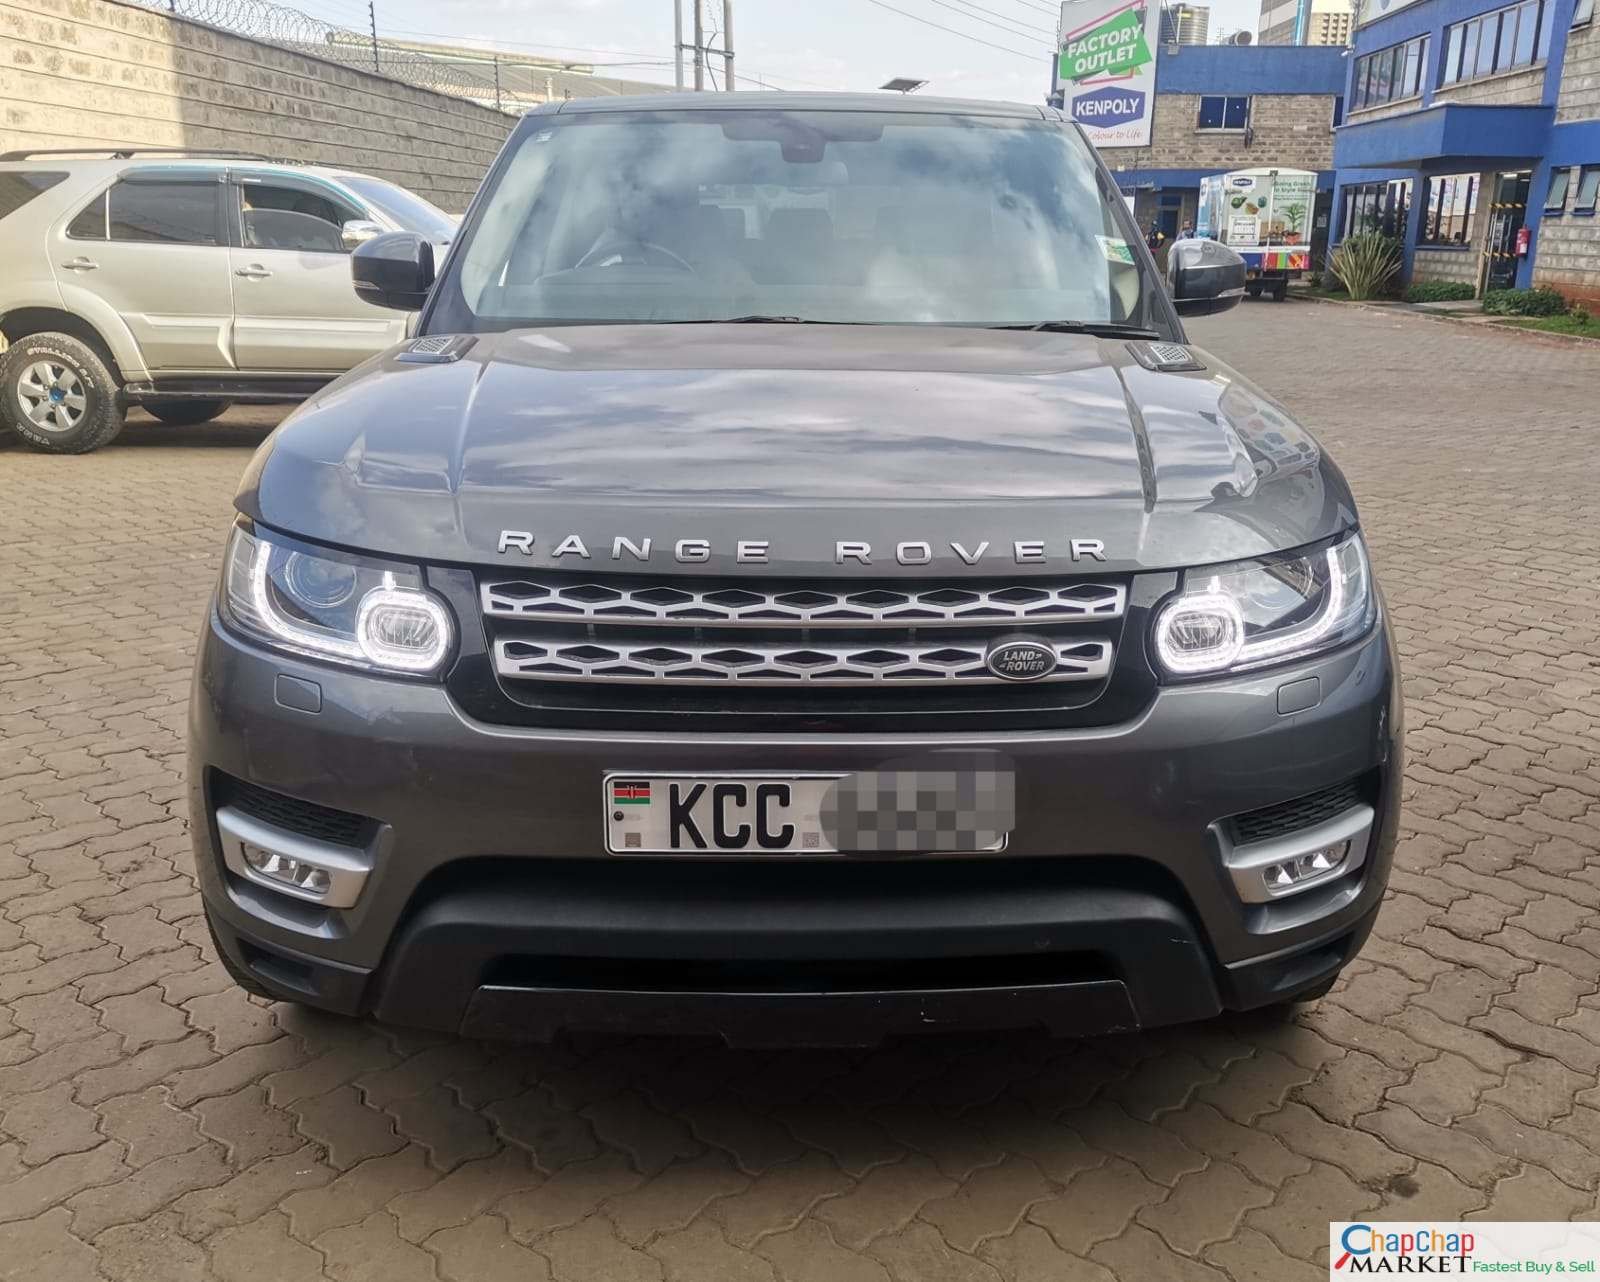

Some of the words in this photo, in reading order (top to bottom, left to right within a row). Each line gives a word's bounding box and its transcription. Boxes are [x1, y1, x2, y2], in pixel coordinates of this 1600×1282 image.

[1067, 24, 1142, 58] FACTORY
[1075, 44, 1136, 74] OUTLET
[1075, 98, 1139, 116] KENPOLY
[498, 530, 769, 563] RANGE
[836, 538, 1107, 565] ROVER
[1003, 651, 1036, 661] LAND
[1006, 661, 1045, 671] ROVER
[669, 783, 795, 849] KCC
